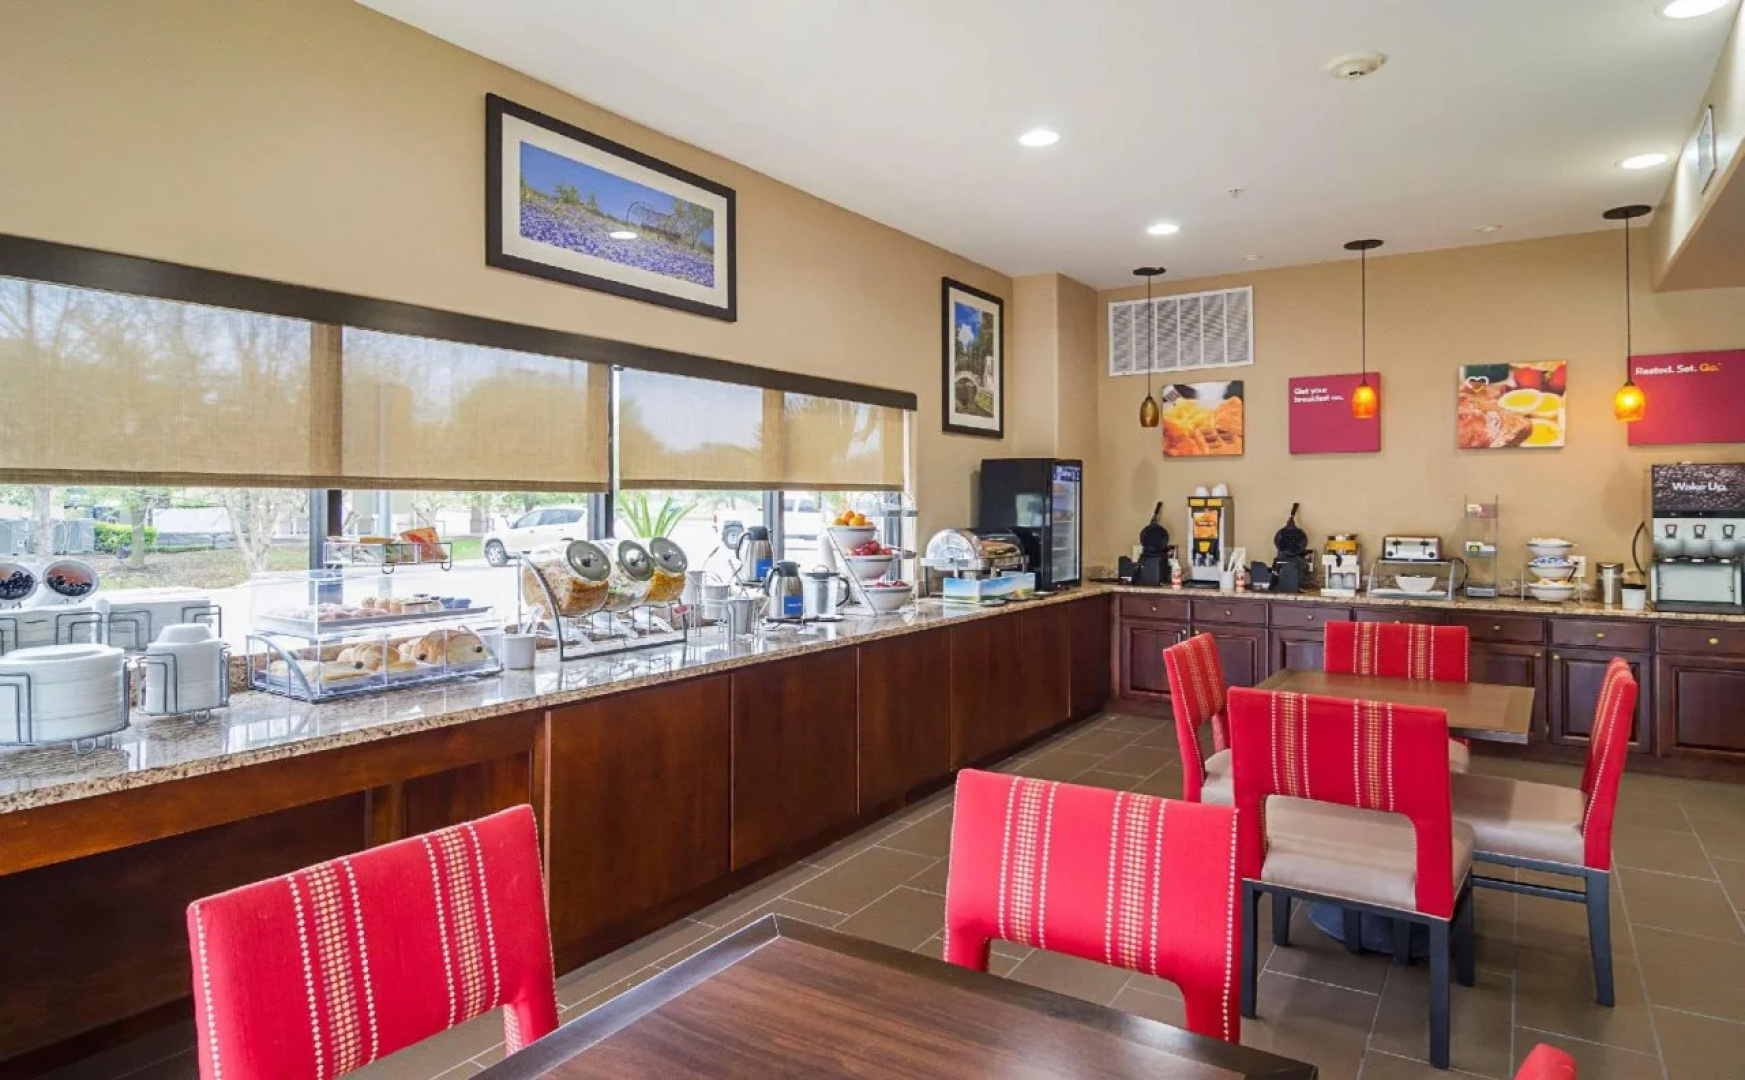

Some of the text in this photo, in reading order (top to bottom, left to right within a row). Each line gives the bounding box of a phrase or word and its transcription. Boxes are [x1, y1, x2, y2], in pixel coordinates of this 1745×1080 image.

[1635, 365, 1675, 375] Rested.
[1676, 364, 1698, 373] Set.
[1672, 482, 1707, 491] Wake
